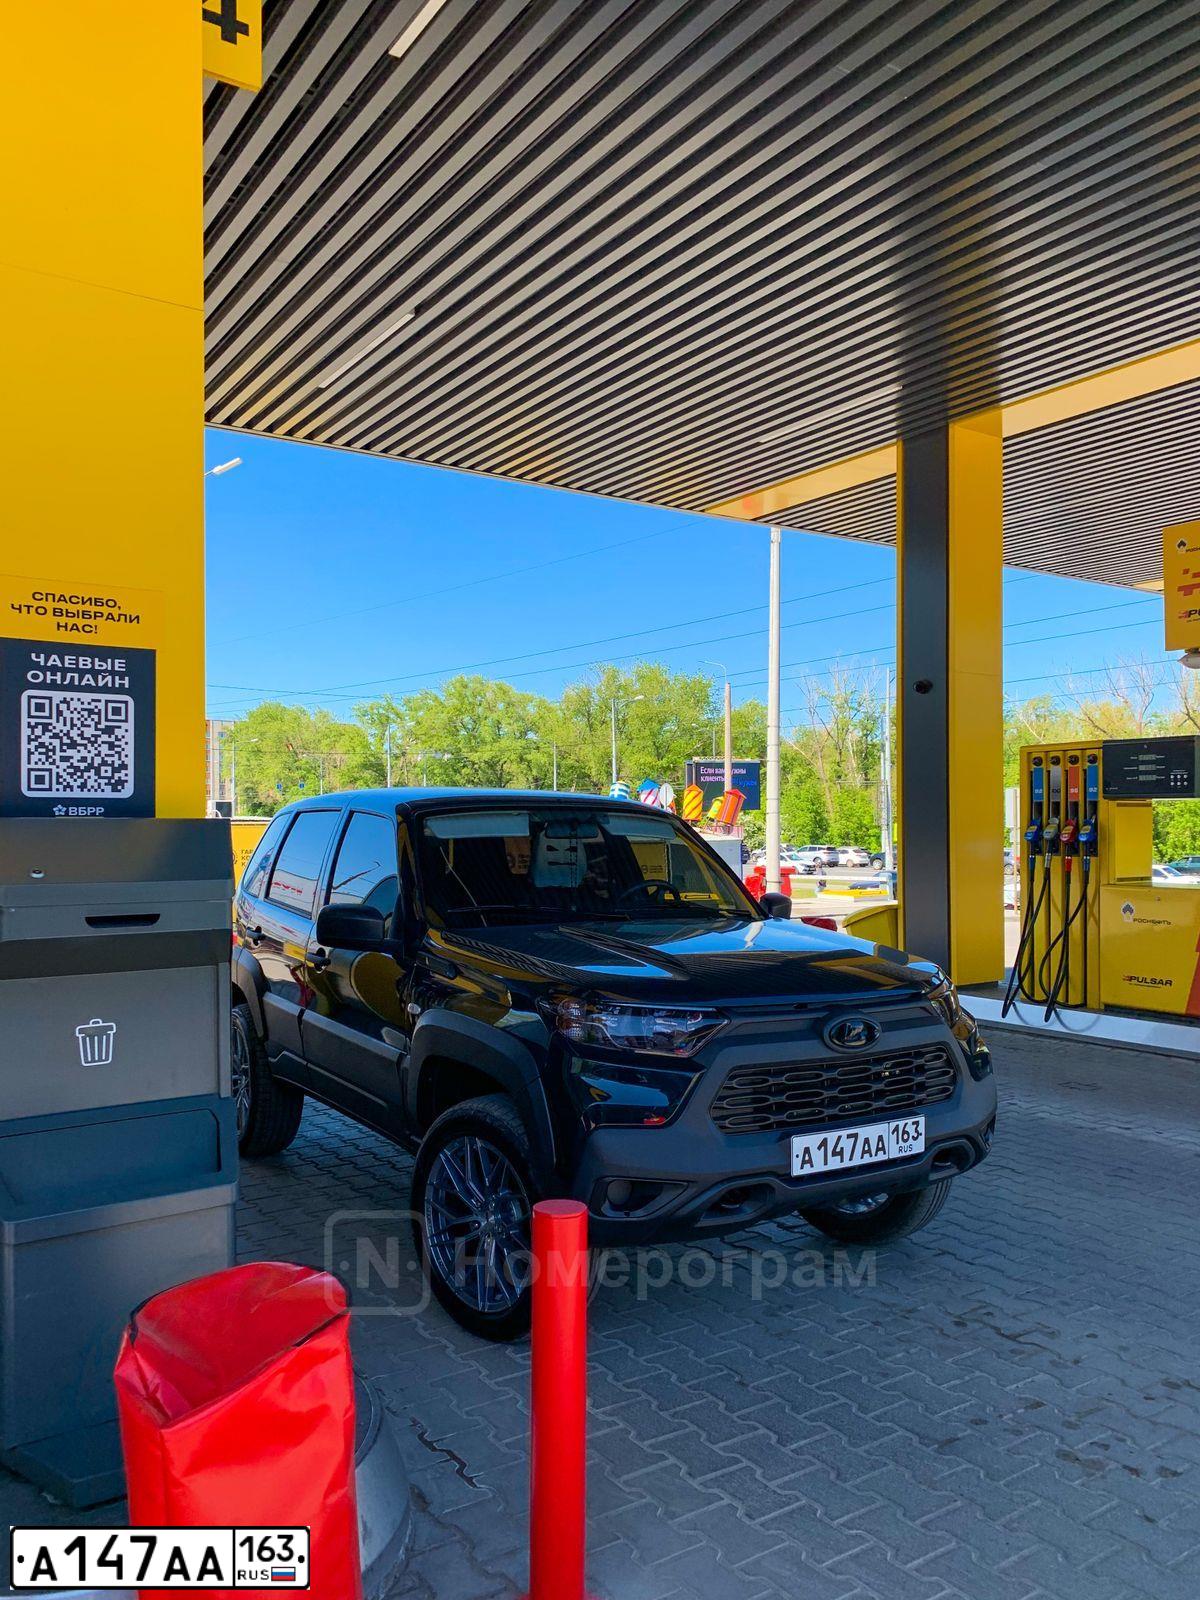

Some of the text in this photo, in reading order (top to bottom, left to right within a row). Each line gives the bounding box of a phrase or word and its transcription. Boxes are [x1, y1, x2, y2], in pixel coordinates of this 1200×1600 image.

[32, 591, 122, 611] СПАСИБО,
[11, 603, 140, 625] ЧТО ВЫБРАЛИ
[56, 621, 98, 635] НАС!
[31, 652, 126, 671] ЧАЕВЫЕ
[26, 670, 130, 688] ОНЛАЙН
[68, 806, 105, 817] ВБРР
[1129, 975, 1174, 988] PULSAR
[891, 1120, 921, 1145] 163
[898, 1144, 913, 1154] RUS
